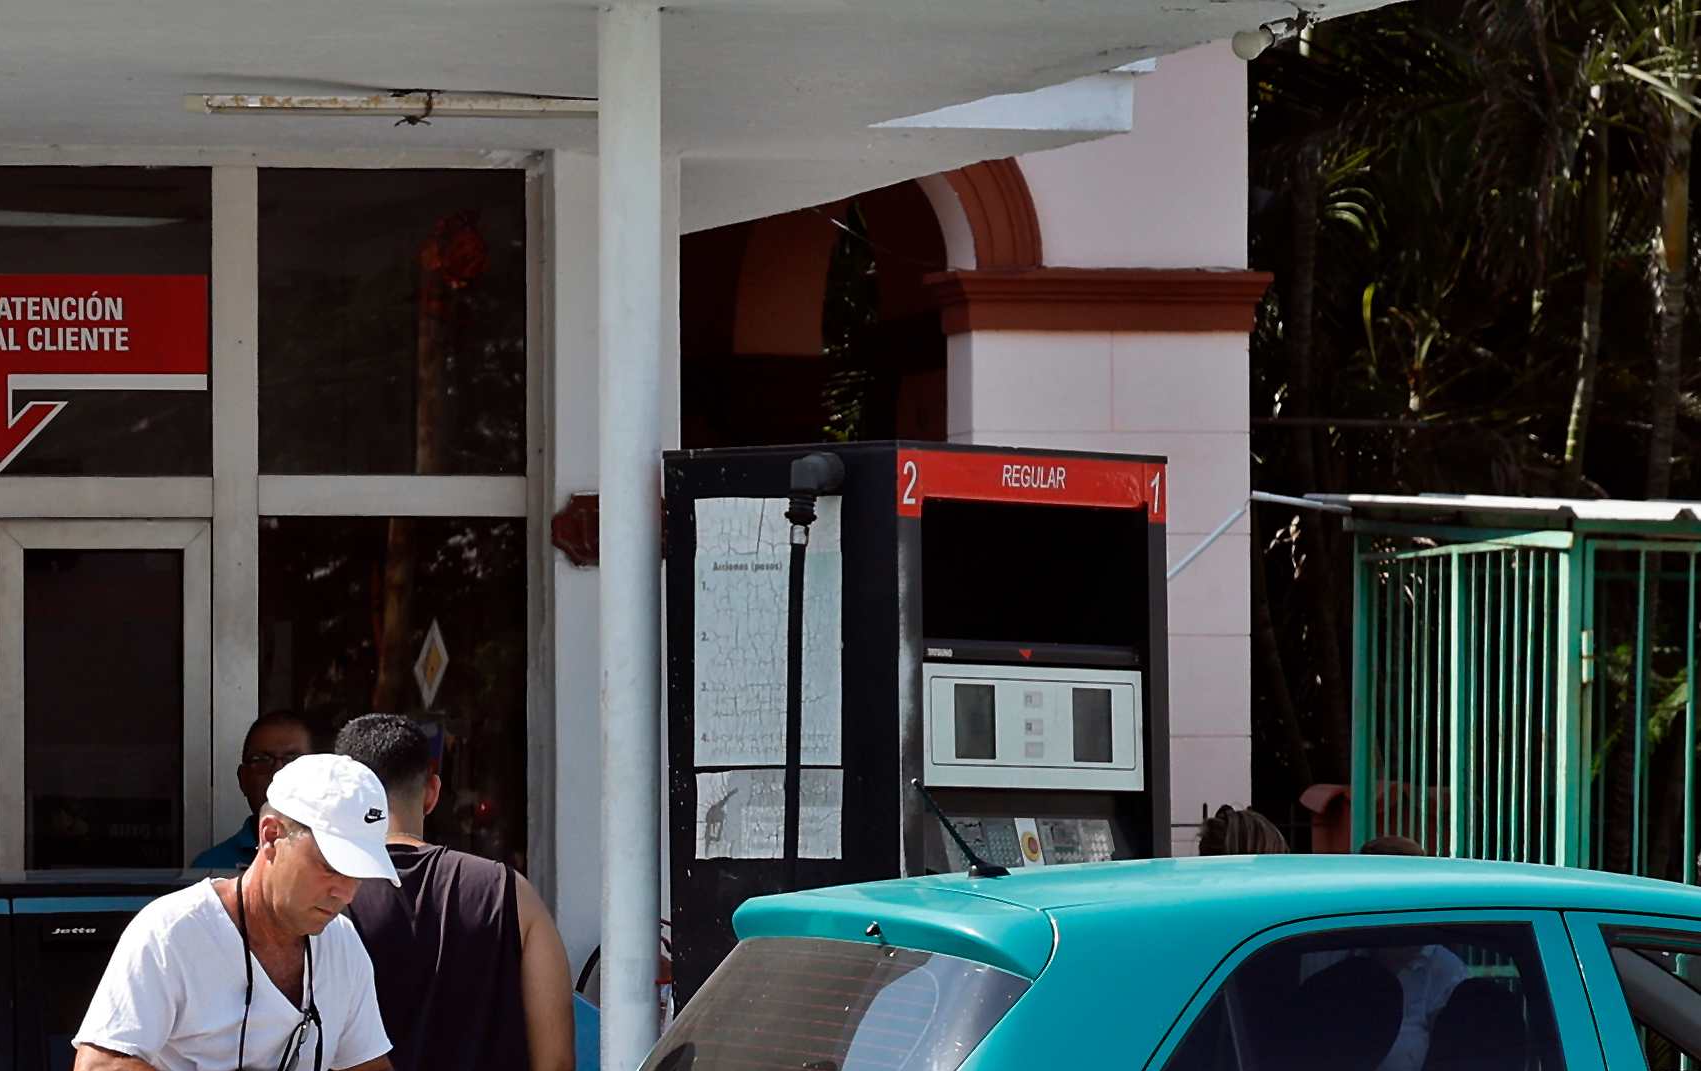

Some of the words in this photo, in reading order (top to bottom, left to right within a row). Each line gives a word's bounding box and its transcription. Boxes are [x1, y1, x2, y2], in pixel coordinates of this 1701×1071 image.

[27, 327, 129, 351] CLIENTE
[903, 460, 917, 505] 2
[1002, 464, 1066, 489] REGULAR
[1150, 471, 1160, 514] 1
[51, 927, 96, 935] Jetta
